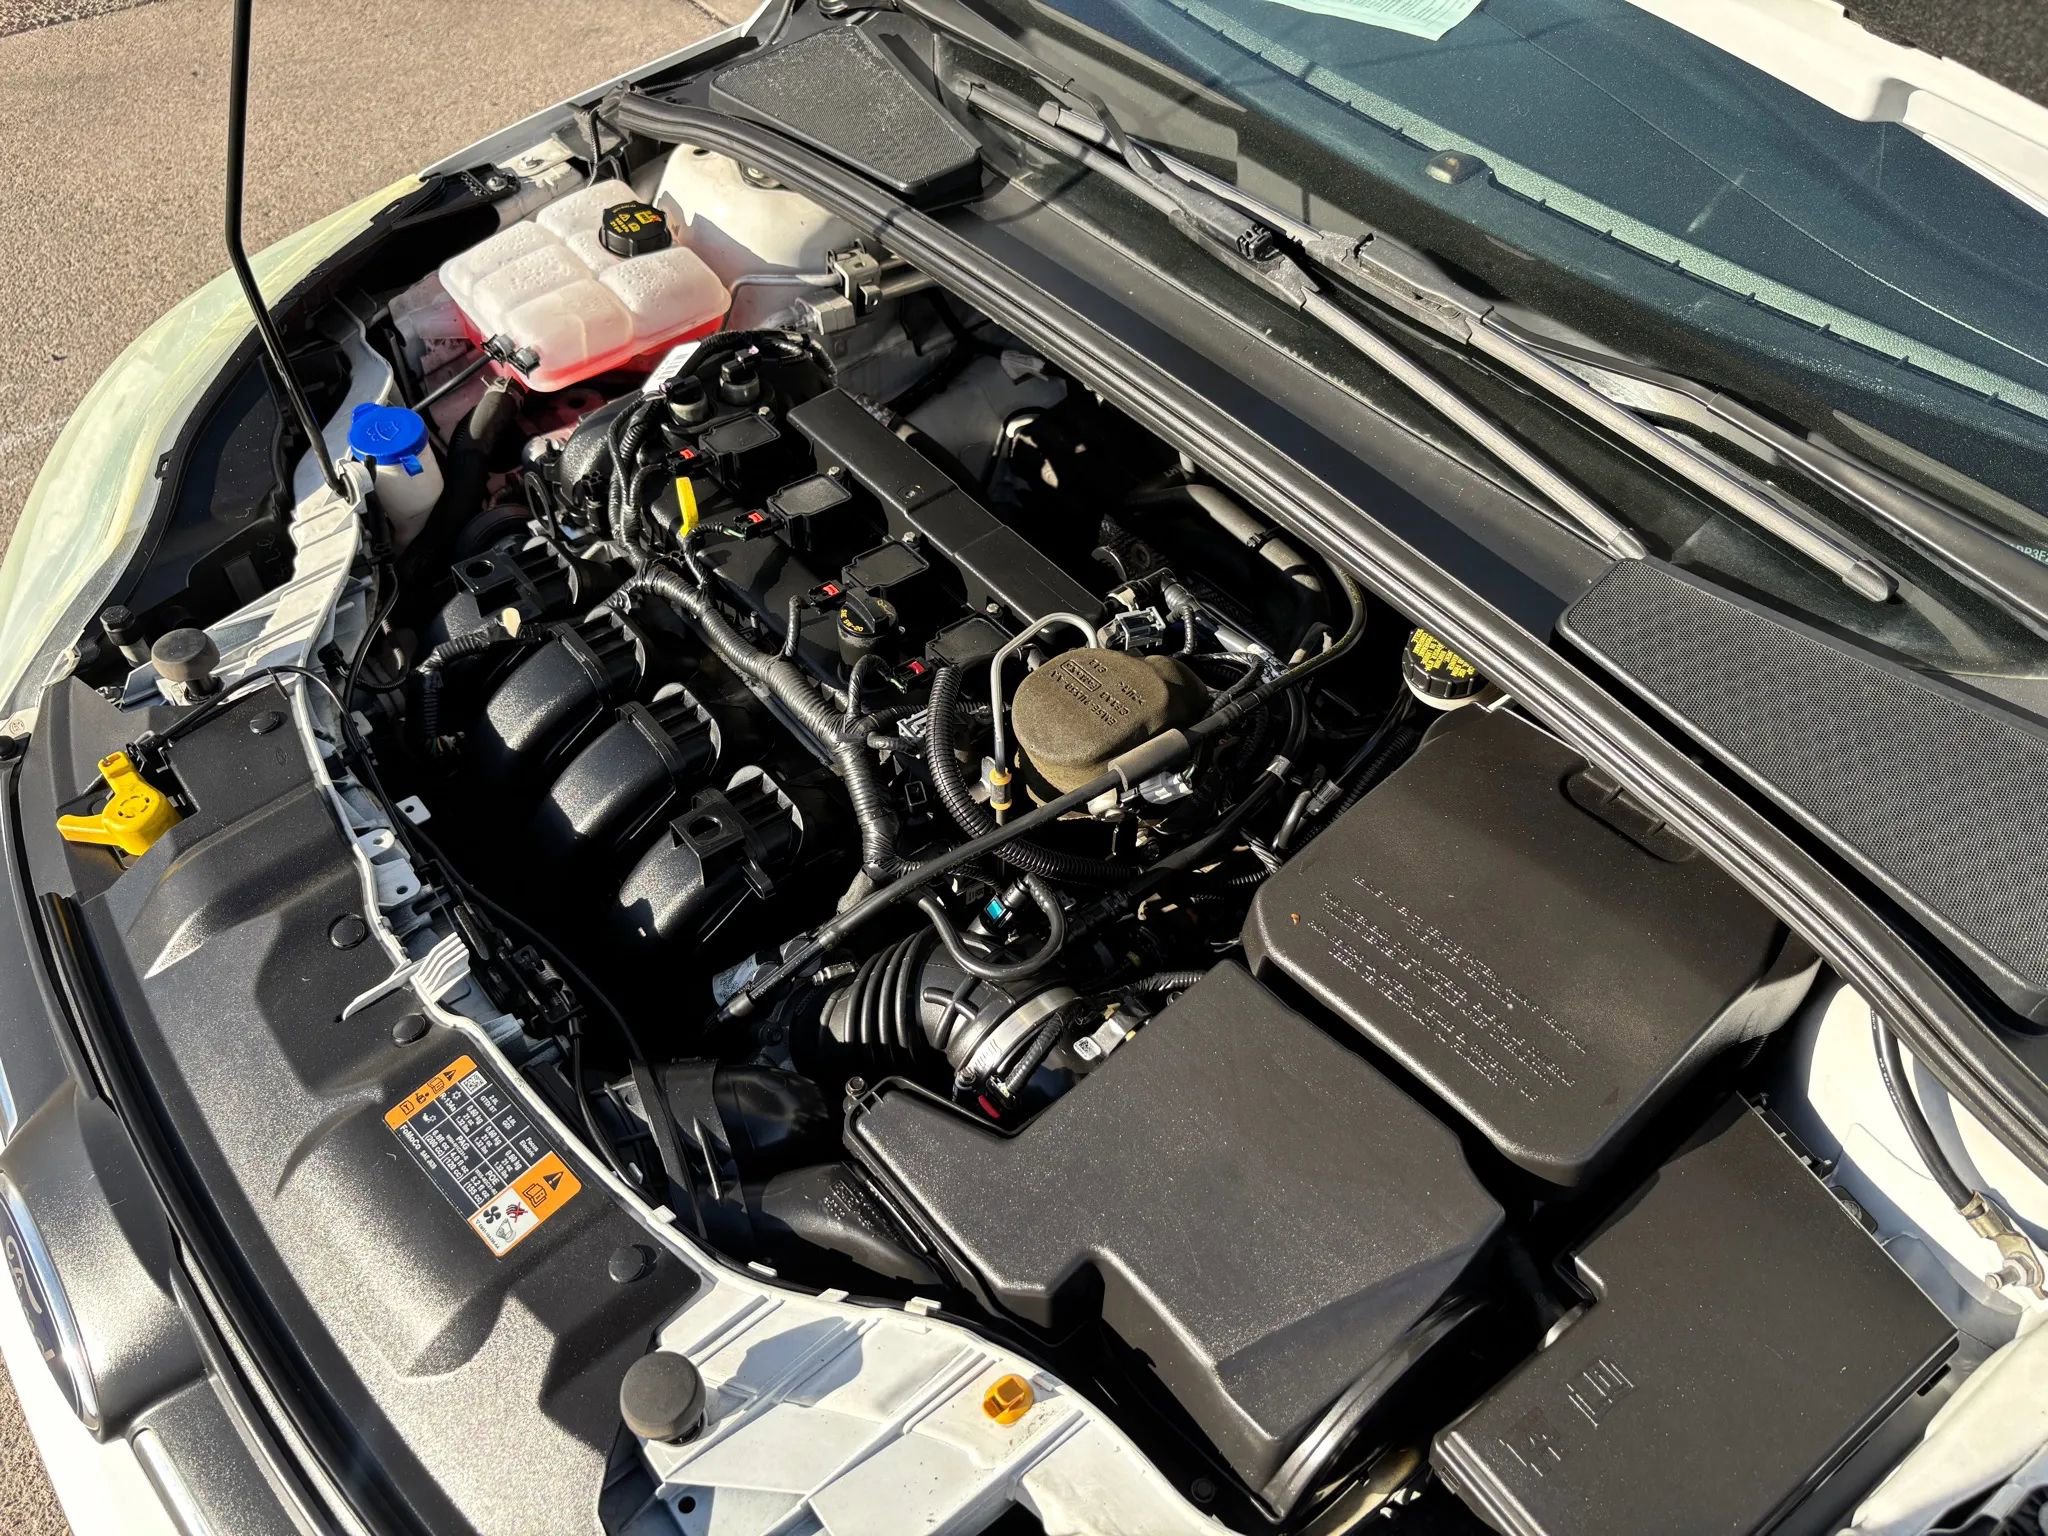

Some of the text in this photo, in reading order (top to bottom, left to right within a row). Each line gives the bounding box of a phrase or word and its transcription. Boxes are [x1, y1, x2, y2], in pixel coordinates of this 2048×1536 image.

[844, 618, 864, 632] 5W-20
[438, 1091, 458, 1113] R-134a
[479, 1094, 491, 1108] GTDI
[462, 1112, 470, 1121] 21
[472, 1113, 485, 1126] kg
[501, 1119, 512, 1130] GDI
[398, 1123, 423, 1151] FoMoCo
[419, 1149, 430, 1161] SAE
[423, 1132, 446, 1157] (200 cc)
[440, 1141, 450, 1150] oz
[455, 1134, 470, 1151] PAG
[480, 1133, 489, 1142] 21
[491, 1134, 503, 1146] kg
[525, 1136, 540, 1152] Focus
[518, 1139, 535, 1158] Electric
[442, 1155, 464, 1180] (120 cc)
[449, 1150, 469, 1174] 4.0 fl oz
[500, 1157, 509, 1166] 21
[511, 1159, 524, 1171] kg
[484, 1169, 500, 1186] POE
[461, 1179, 485, 1205] (155 cc)
[469, 1174, 490, 1199] 5.2 fl oz
